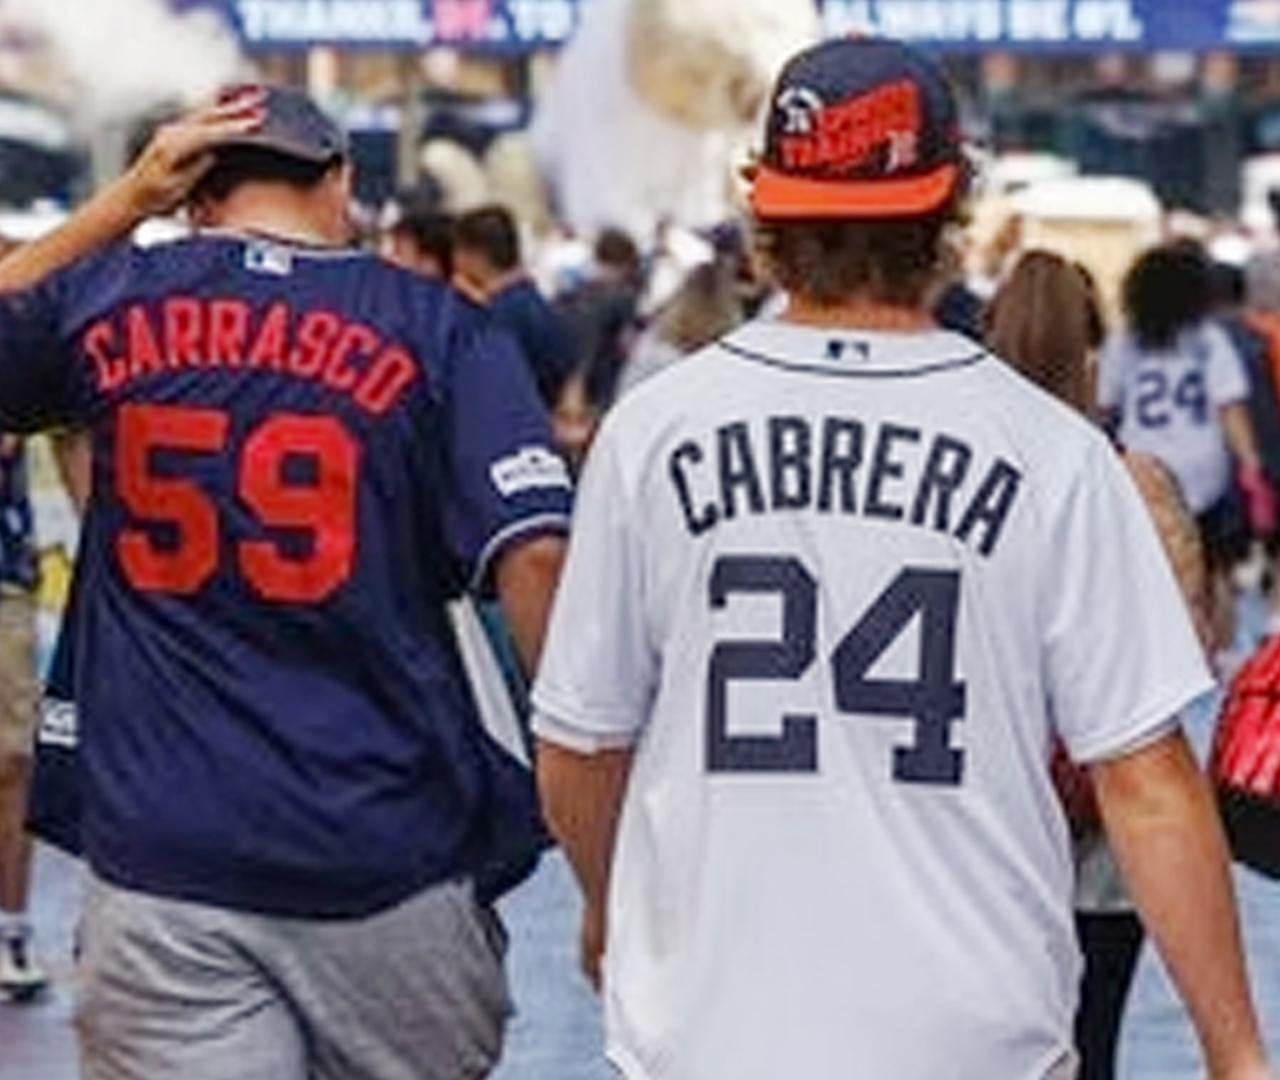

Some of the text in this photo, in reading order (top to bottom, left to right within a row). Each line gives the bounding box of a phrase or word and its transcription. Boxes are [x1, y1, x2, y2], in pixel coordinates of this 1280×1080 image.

[83, 297, 416, 414] CARRASCO
[1136, 370, 1208, 428] 24
[114, 402, 360, 602] 59
[668, 416, 1024, 558] CABRERA
[705, 554, 969, 787] 24
